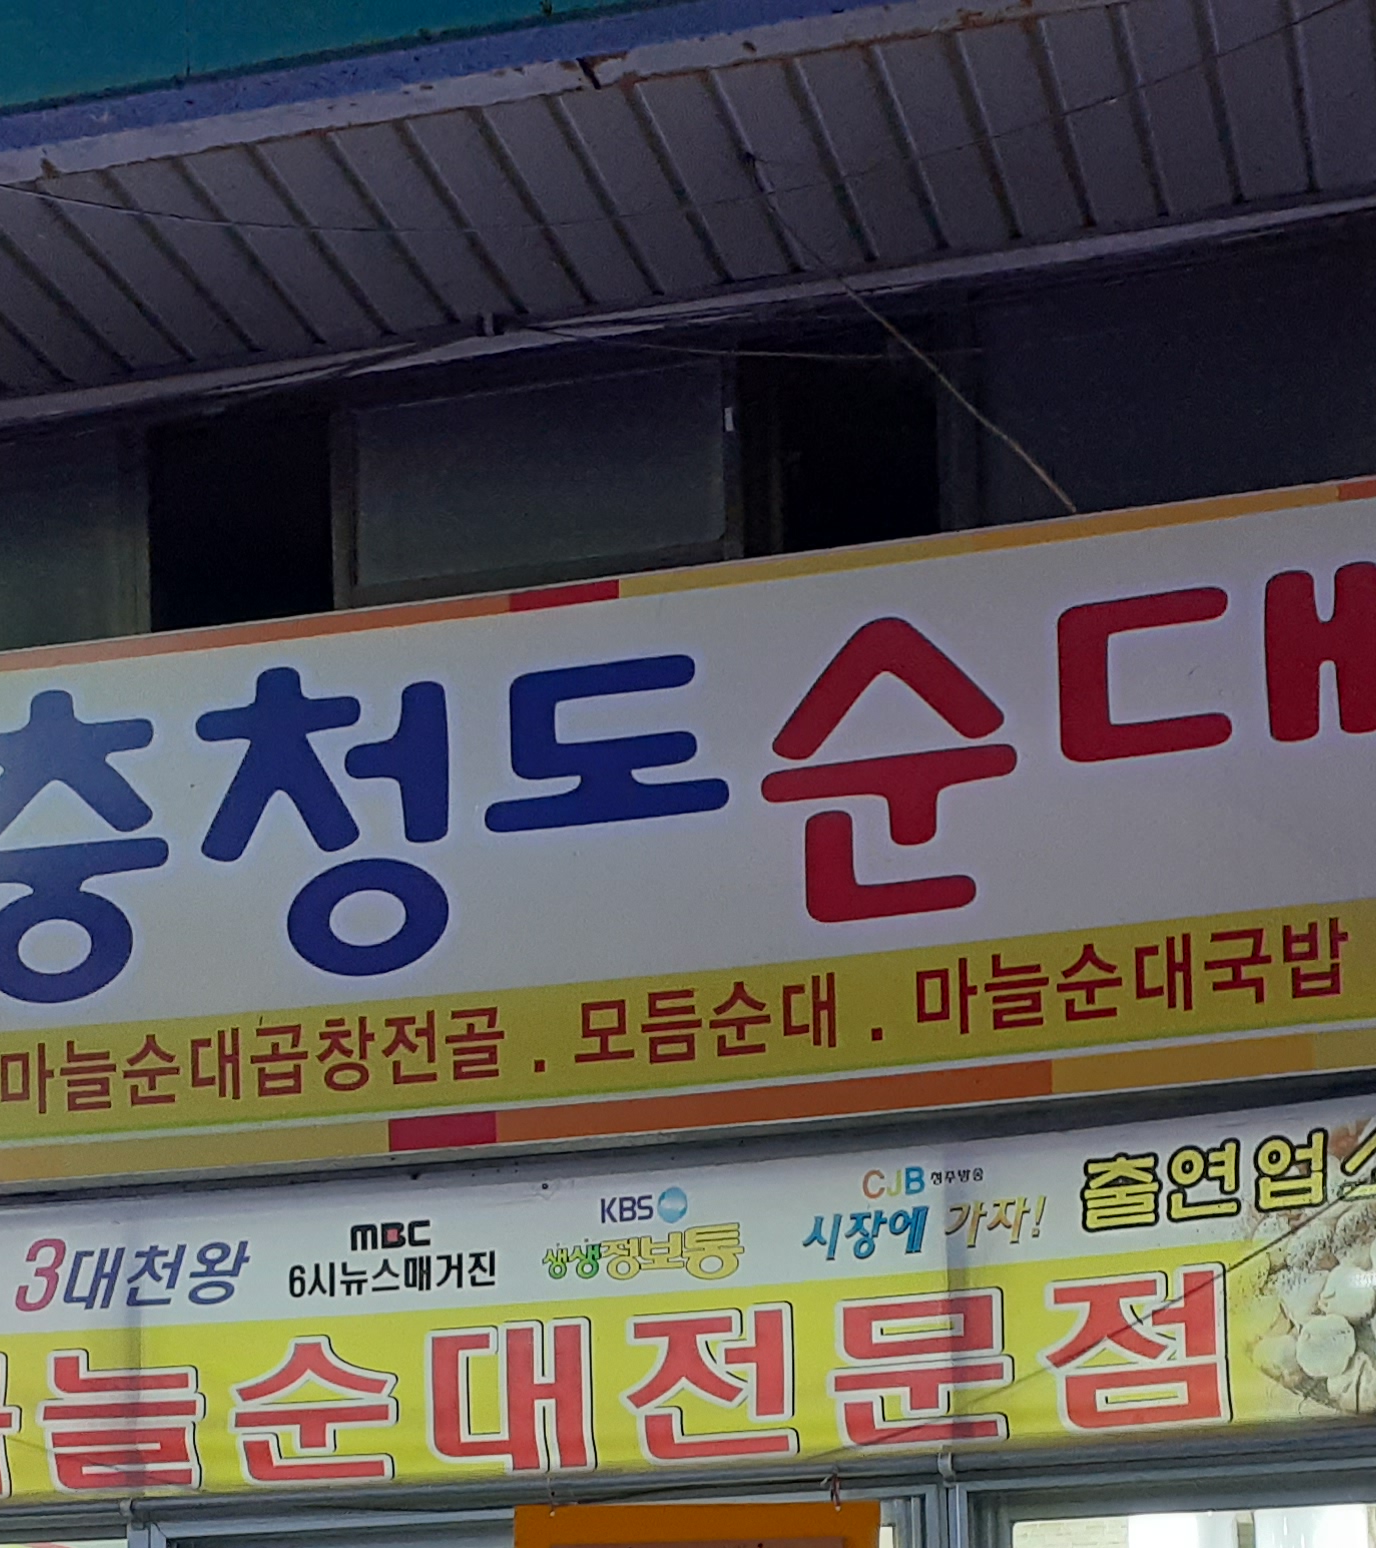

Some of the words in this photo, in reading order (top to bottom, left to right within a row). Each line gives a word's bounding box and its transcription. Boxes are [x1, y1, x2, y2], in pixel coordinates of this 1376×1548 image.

[573, 972, 838, 1066] 모듬순대
[915, 916, 1350, 1036] 마늘순대국밥
[600, 1195, 655, 1224] KBS
[862, 1166, 925, 1200] CJB
[350, 1219, 432, 1252] MBC
[542, 1222, 745, 1282] 생생정보통
[802, 1205, 931, 1262] 시장에
[945, 1195, 1047, 1249] 가자!
[15, 1237, 252, 1312] 3대천왕
[288, 1250, 498, 1300] 6시뉴스매거진
